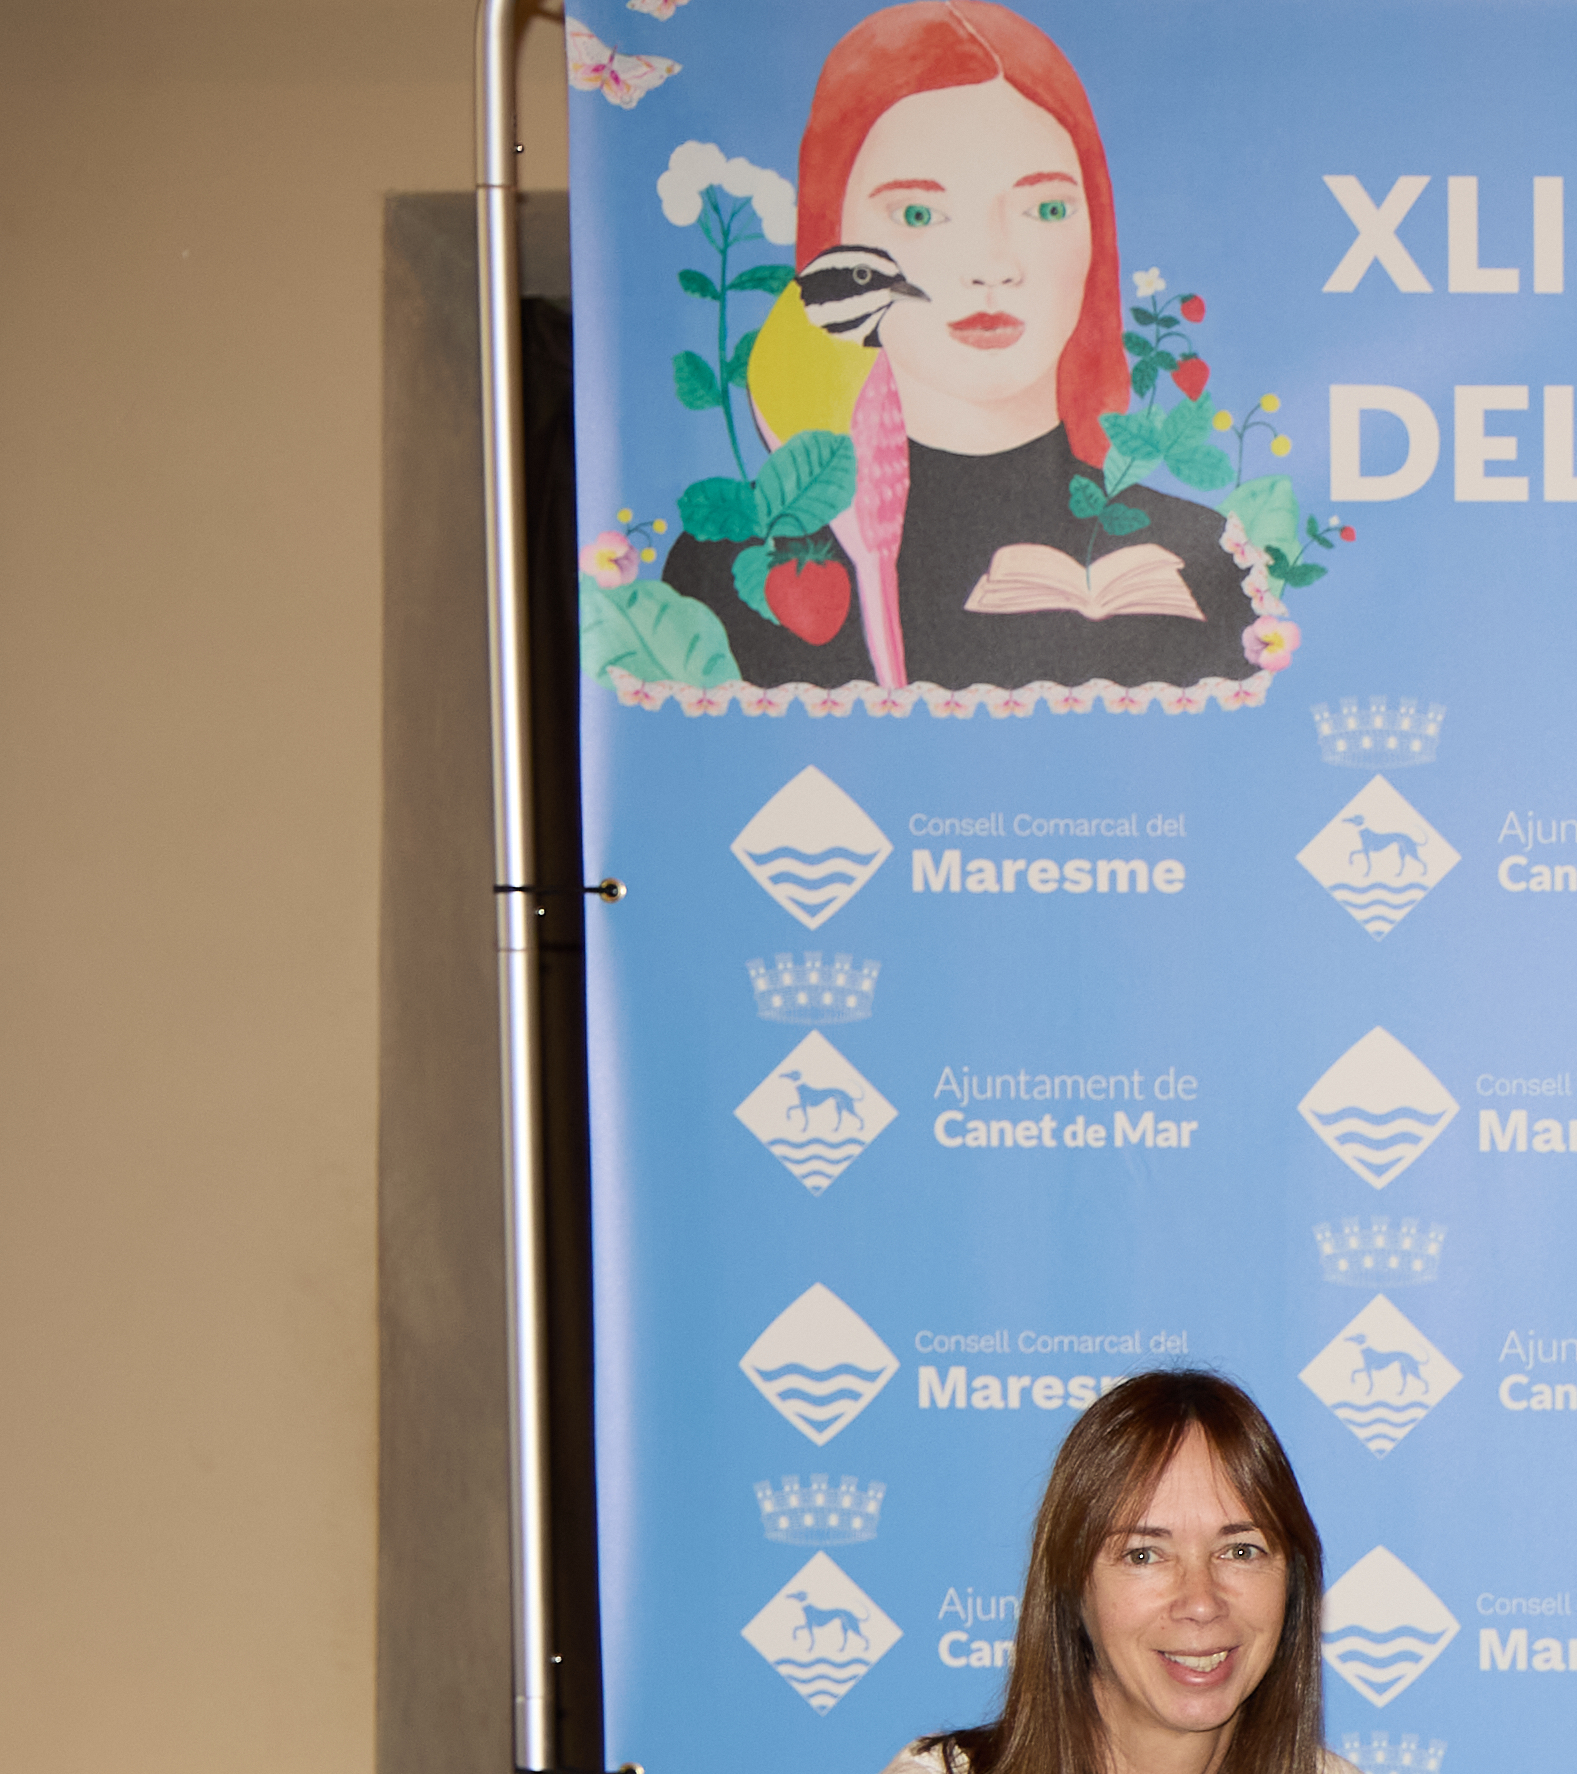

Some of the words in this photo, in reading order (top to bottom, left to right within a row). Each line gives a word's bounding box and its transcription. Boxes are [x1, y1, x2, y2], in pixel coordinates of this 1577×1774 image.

[908, 811, 1007, 837] Consell
[1012, 812, 1141, 838] Comarcal
[1145, 812, 1187, 838] del
[912, 848, 1187, 894] Maresme
[933, 1065, 1146, 1108] Ajuntament
[1153, 1065, 1199, 1101] de
[1475, 1072, 1573, 1097] Consell
[933, 1109, 1058, 1149] Canet
[1062, 1114, 1107, 1149] de
[1113, 1110, 1199, 1148] Mar
[914, 1328, 1012, 1354] Consell
[1016, 1328, 1145, 1356] Comarcal
[1148, 1329, 1189, 1354] del
[918, 1365, 1124, 1410] Mares
[1476, 1591, 1571, 1616] Consell
[938, 1630, 1017, 1668] Can
